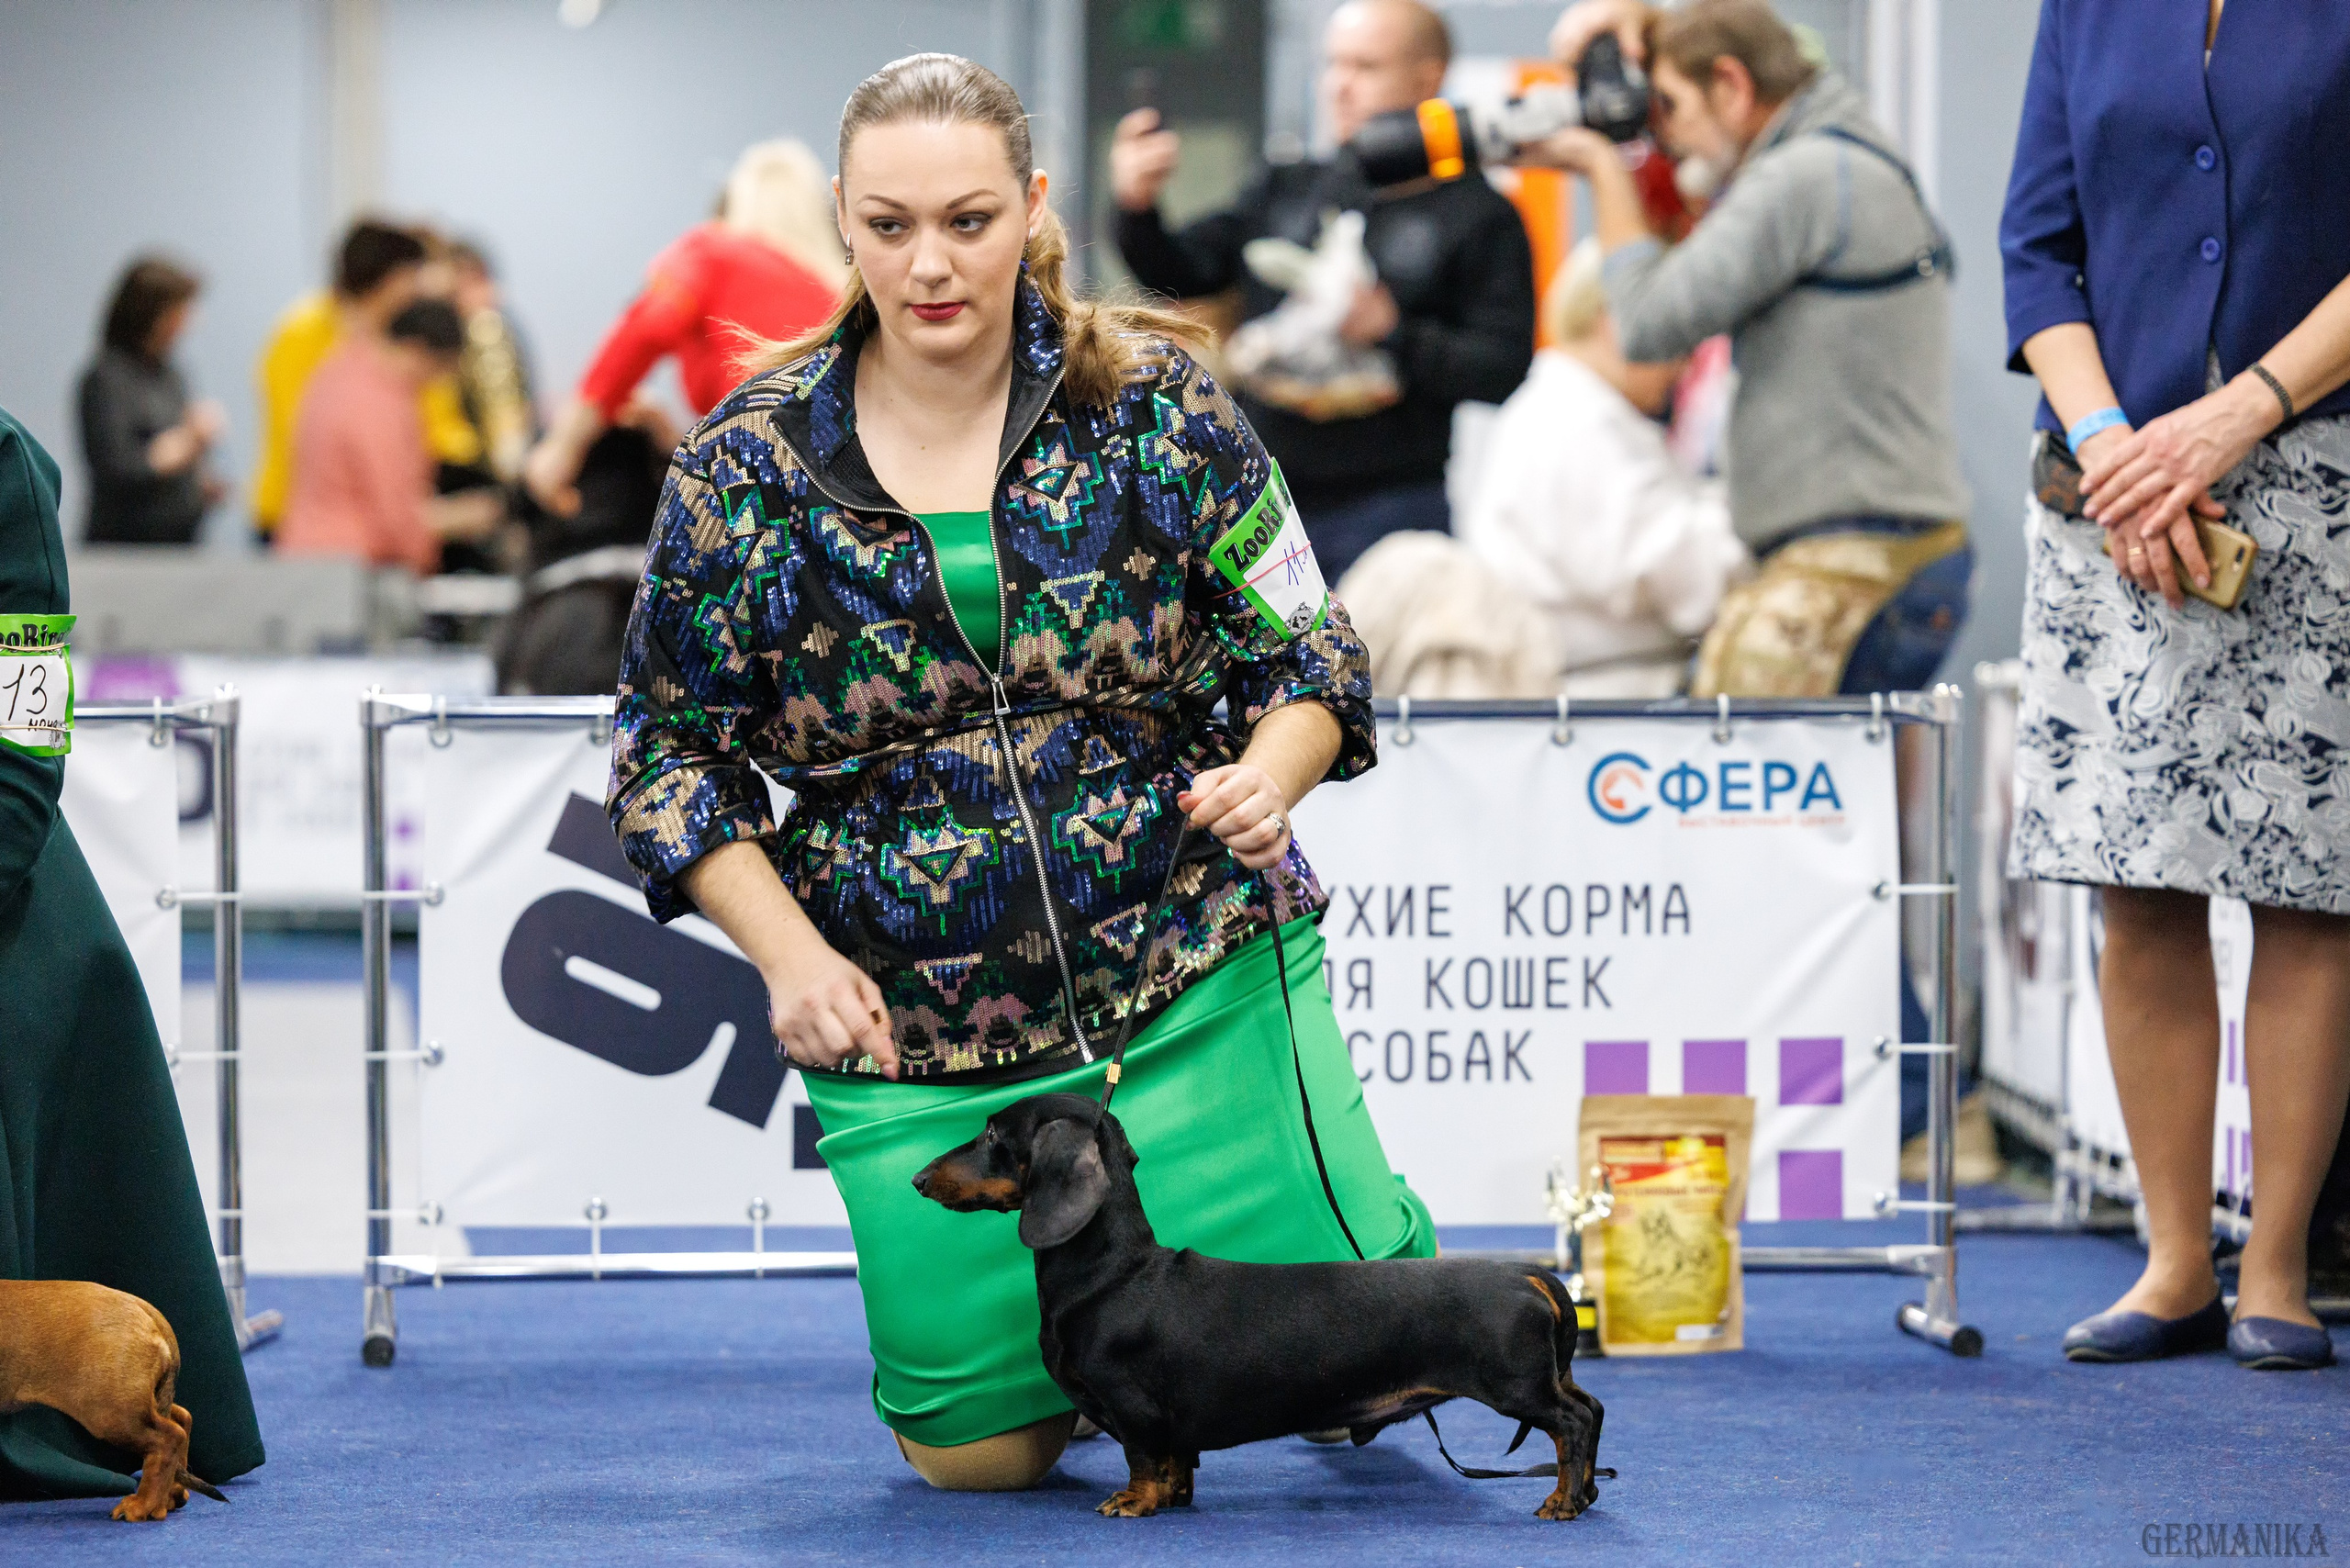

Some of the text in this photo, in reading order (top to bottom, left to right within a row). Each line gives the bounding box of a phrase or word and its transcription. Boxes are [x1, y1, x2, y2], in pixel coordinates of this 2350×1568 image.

[3, 664, 48, 722] 13
[1587, 752, 1843, 825] СФЕРА
[1330, 882, 1692, 938] ХИЕ КОРМА
[1426, 956, 1613, 1010] КОШЕК
[1346, 1029, 1534, 1084] СОБАК
